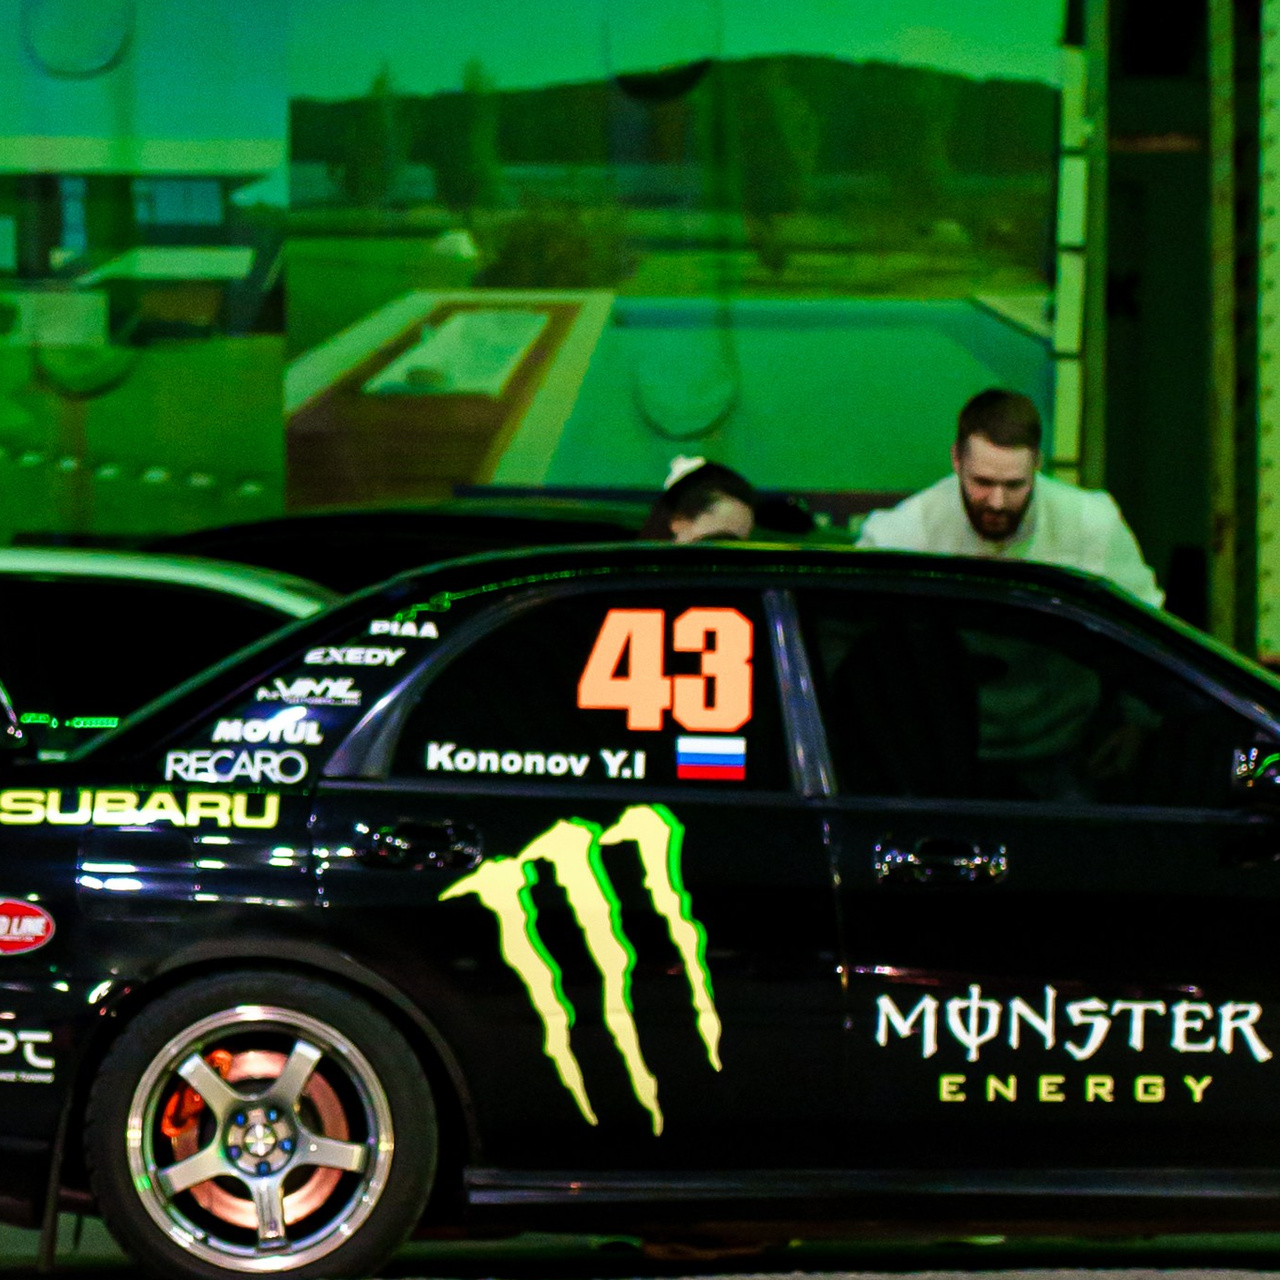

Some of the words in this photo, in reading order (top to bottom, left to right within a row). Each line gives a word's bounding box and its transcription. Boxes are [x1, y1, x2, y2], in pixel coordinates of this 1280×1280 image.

[303, 646, 406, 667] EXEDY
[577, 606, 753, 732] 43
[211, 718, 324, 745] MOTUL
[164, 749, 308, 784] RECARO
[426, 741, 590, 776] Kononov
[938, 1074, 1213, 1103] ENERGY
